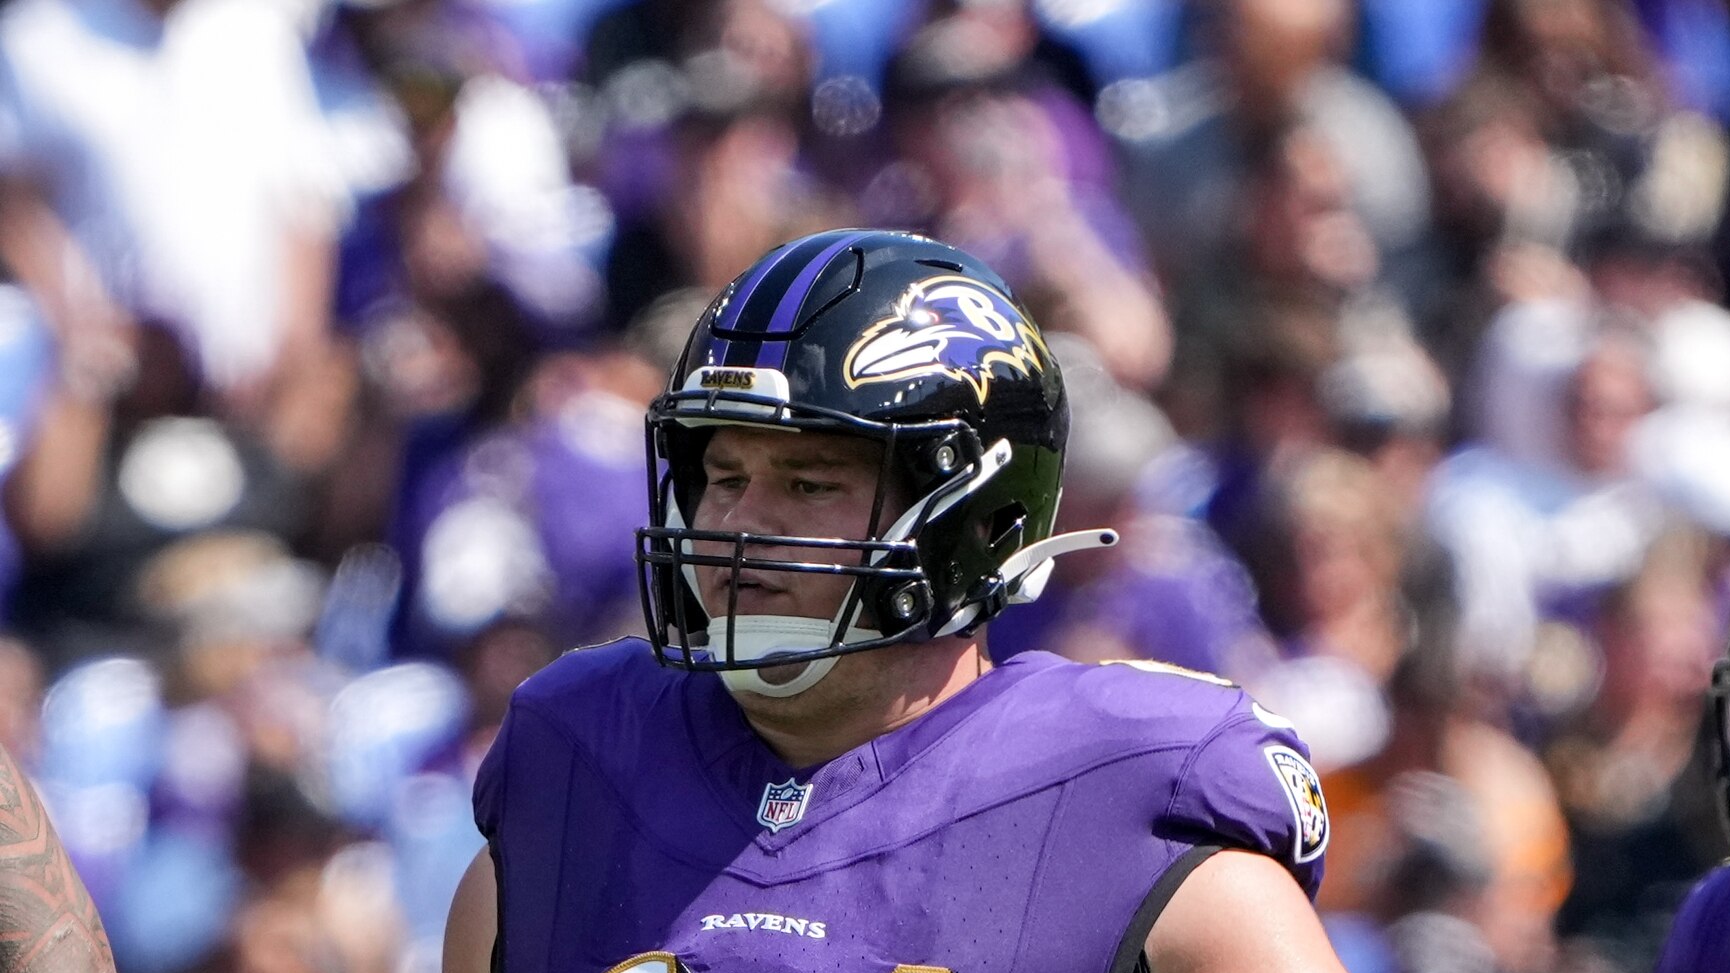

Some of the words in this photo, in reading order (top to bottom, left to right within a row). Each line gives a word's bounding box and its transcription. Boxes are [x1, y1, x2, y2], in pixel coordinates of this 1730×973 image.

[700, 369, 756, 389] RAVENS
[764, 801, 796, 822] NFL
[700, 912, 827, 939] RAVENS
